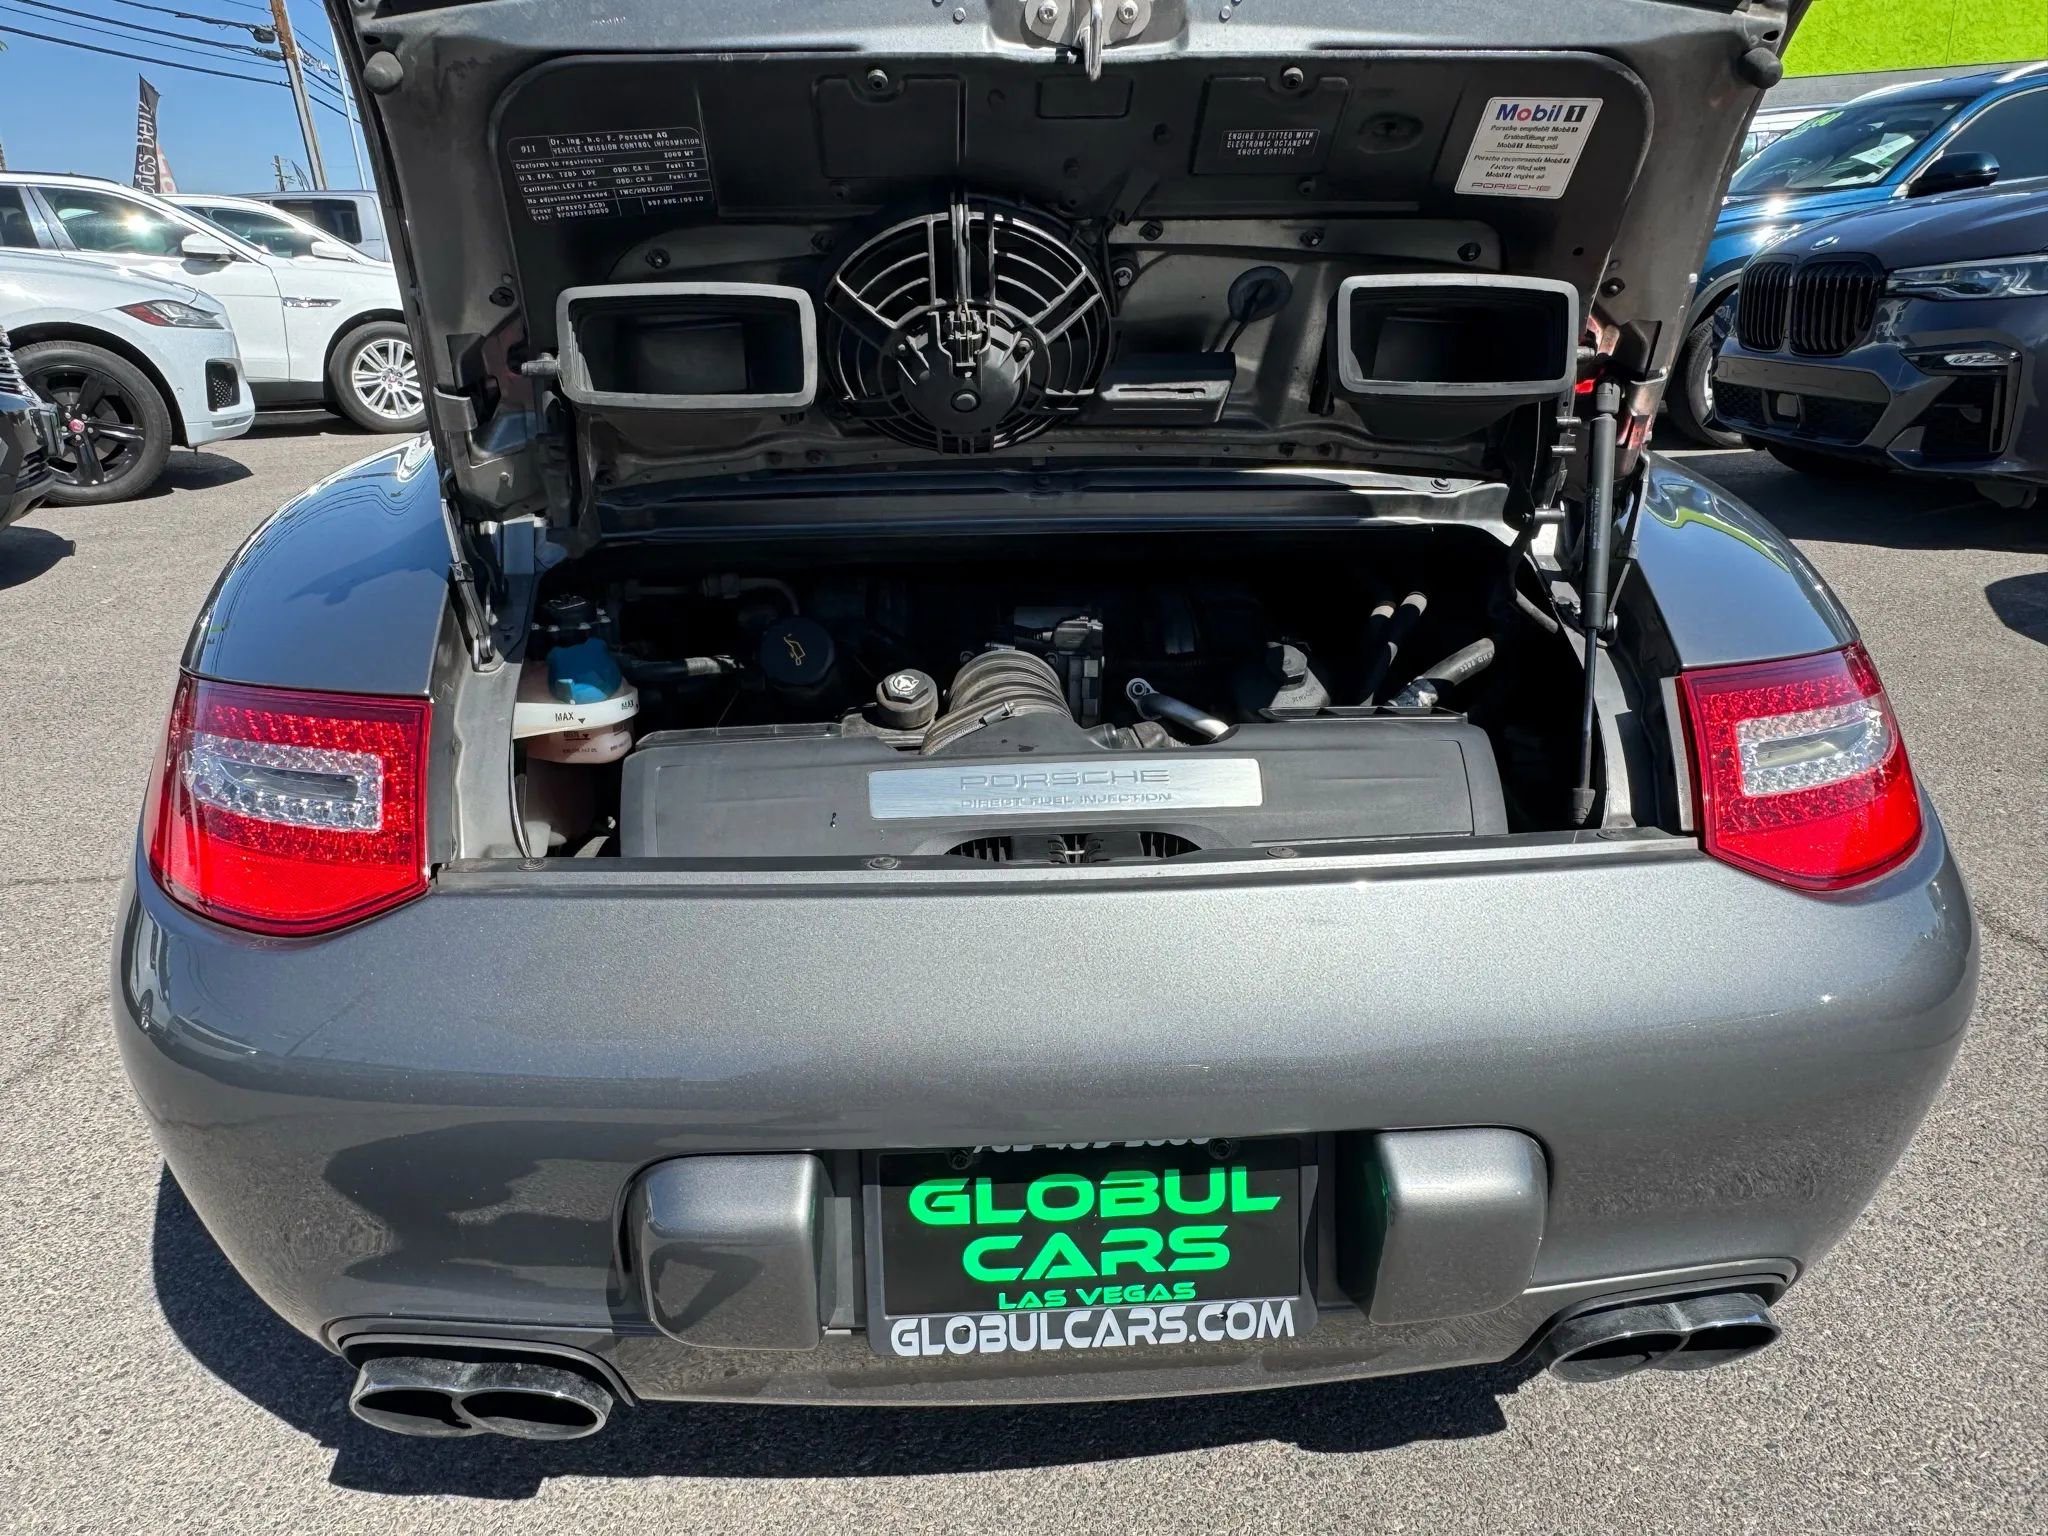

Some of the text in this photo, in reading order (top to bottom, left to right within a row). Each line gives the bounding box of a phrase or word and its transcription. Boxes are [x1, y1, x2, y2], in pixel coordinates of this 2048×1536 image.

[1495, 103, 1563, 122] Mobil
[618, 132, 652, 141] Porsche
[1228, 132, 1254, 140] ENGINE
[1268, 132, 1293, 140] FITTED
[1296, 131, 1314, 139] WITH
[520, 145, 536, 154] 911
[552, 138, 700, 154] VEHICLE EMISSION CONTROL INFORMATION
[1226, 140, 1271, 148] ELECTRONIC
[1264, 147, 1296, 156] CONTROL
[1490, 164, 1514, 172] Factory
[1472, 182, 1552, 192] PORSCHE
[621, 699, 634, 710] MAX
[555, 712, 574, 722] MAX
[960, 769, 1170, 790] PORSCHE
[961, 792, 1172, 809] DIRECT FUEL INJECTION
[908, 1165, 1281, 1226] GLOBUL
[962, 1224, 1230, 1282] CARS
[998, 1281, 1196, 1310] LAS VEGAS
[890, 1300, 1295, 1357] GLOBULCARS.COM
